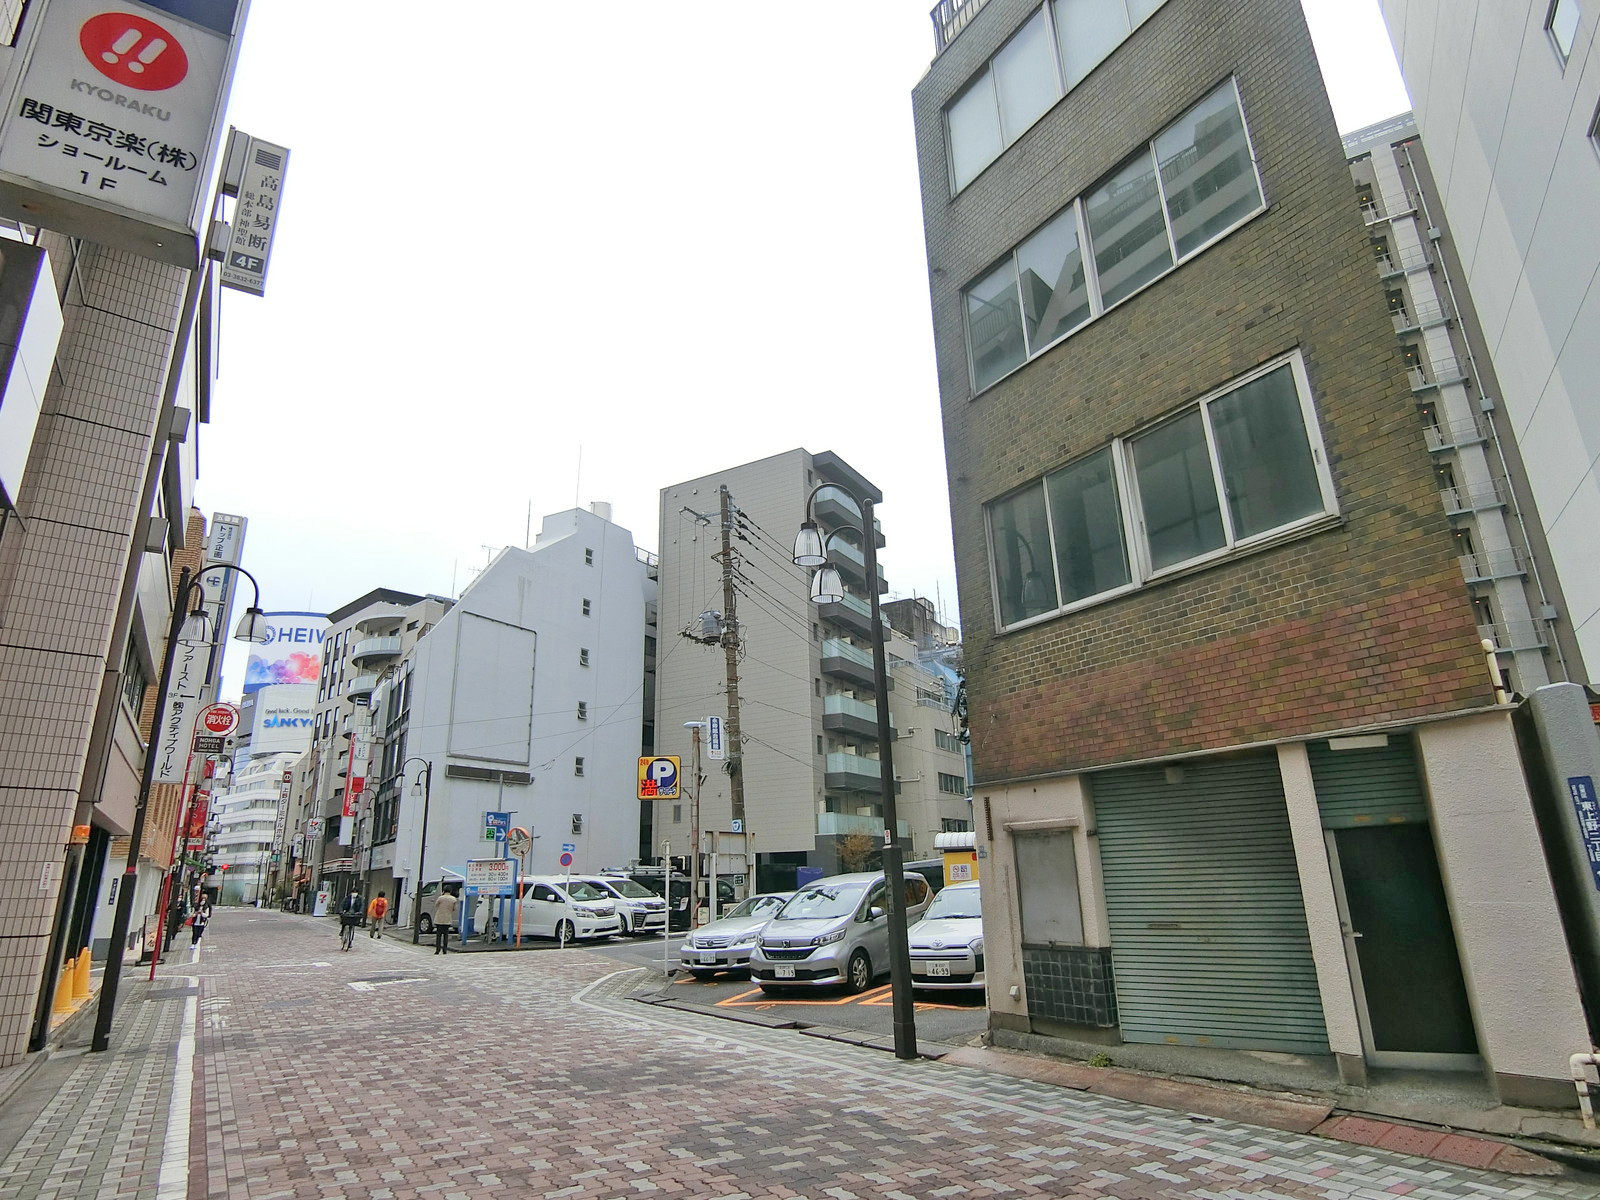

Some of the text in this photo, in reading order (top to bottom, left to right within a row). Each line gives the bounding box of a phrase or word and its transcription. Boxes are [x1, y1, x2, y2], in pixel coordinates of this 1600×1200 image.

[70, 79, 171, 122] KYORAKU
[38, 133, 167, 186] ショールーム
[248, 175, 279, 251] 高島易断
[236, 255, 259, 270] 4F
[206, 714, 232, 726] 消火栓
[652, 760, 675, 787] P
[641, 779, 657, 796] 満
